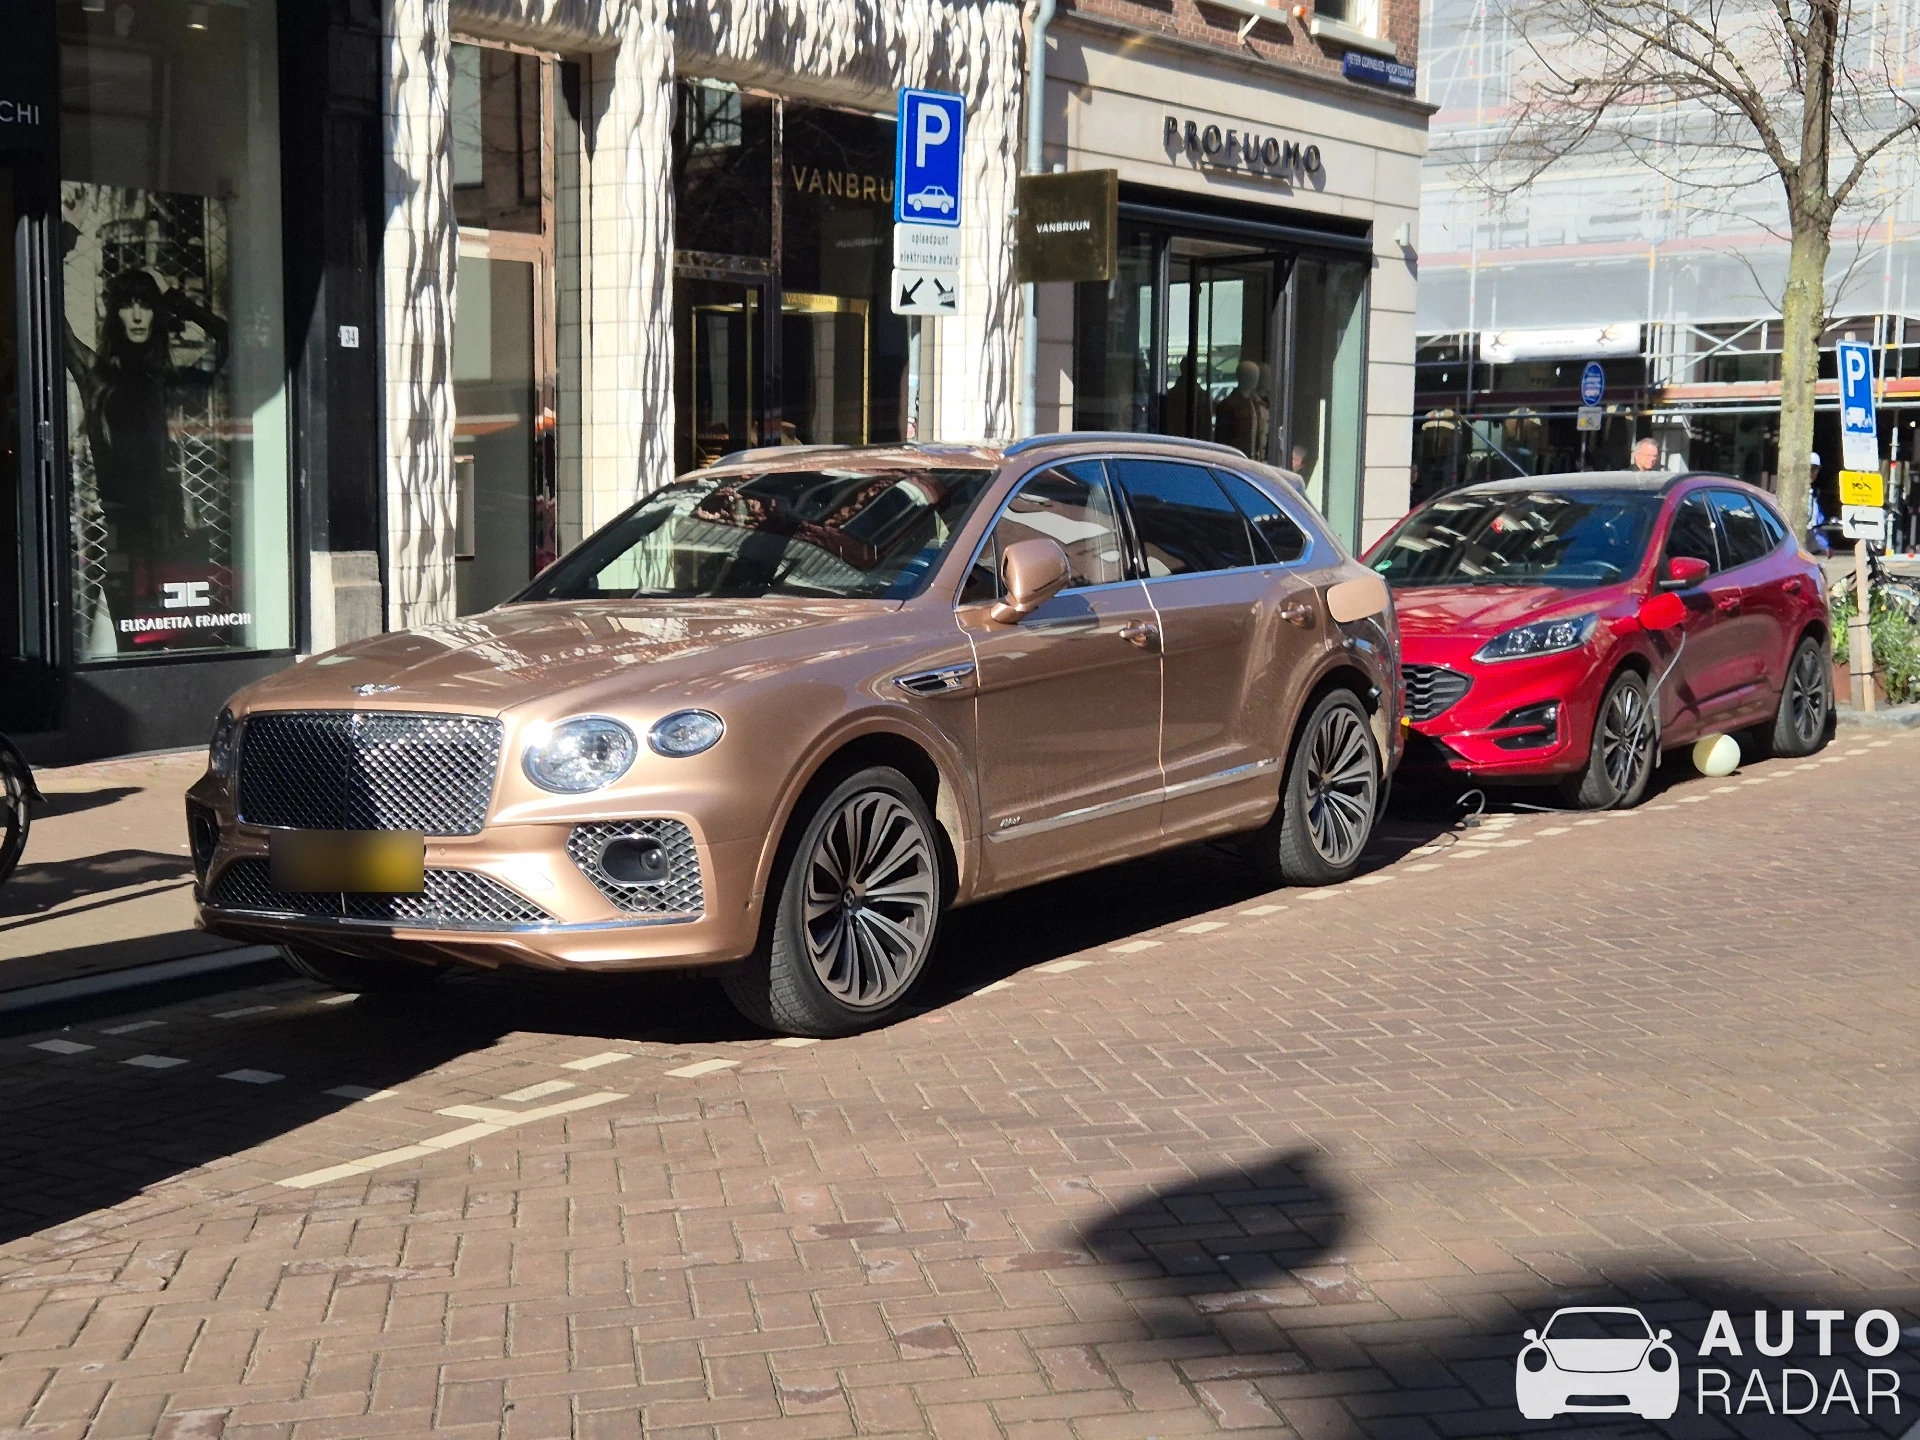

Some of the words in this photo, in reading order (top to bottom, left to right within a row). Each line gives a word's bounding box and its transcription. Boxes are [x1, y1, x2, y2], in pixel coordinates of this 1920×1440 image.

[916, 102, 950, 168] P
[1163, 115, 1321, 173] PROFUOMO
[791, 165, 894, 203] VANBRU
[1036, 220, 1091, 234] VANBRUUN
[911, 232, 949, 246] oplaadpunt
[900, 250, 937, 264] elektrische
[345, 328, 356, 345] 34
[1845, 350, 1866, 398] P
[120, 615, 193, 633] ELISABETTA
[195, 612, 252, 628] FRANCHI
